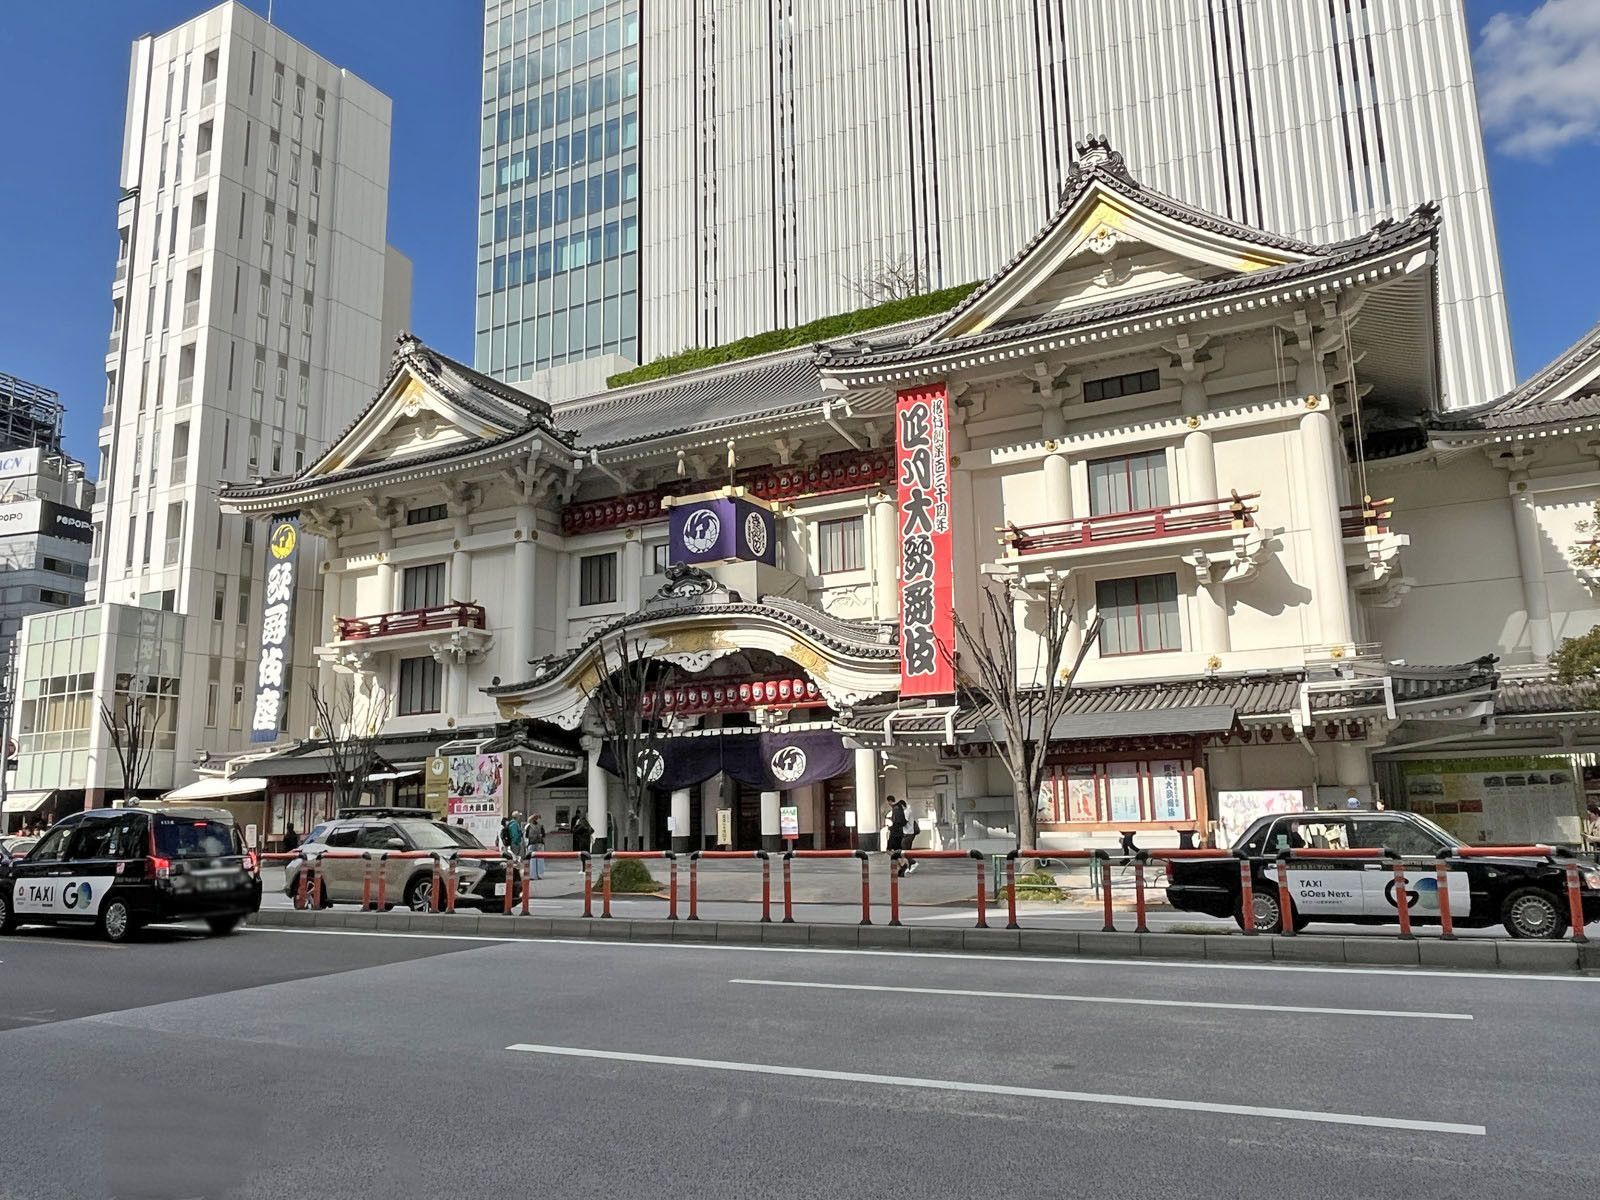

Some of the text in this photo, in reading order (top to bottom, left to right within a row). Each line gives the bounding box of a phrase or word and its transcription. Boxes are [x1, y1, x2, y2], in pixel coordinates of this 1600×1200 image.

[253, 562, 291, 730] 歌舞伎座
[30, 886, 54, 901] TAXI
[1300, 890, 1353, 898] GOes Next.
